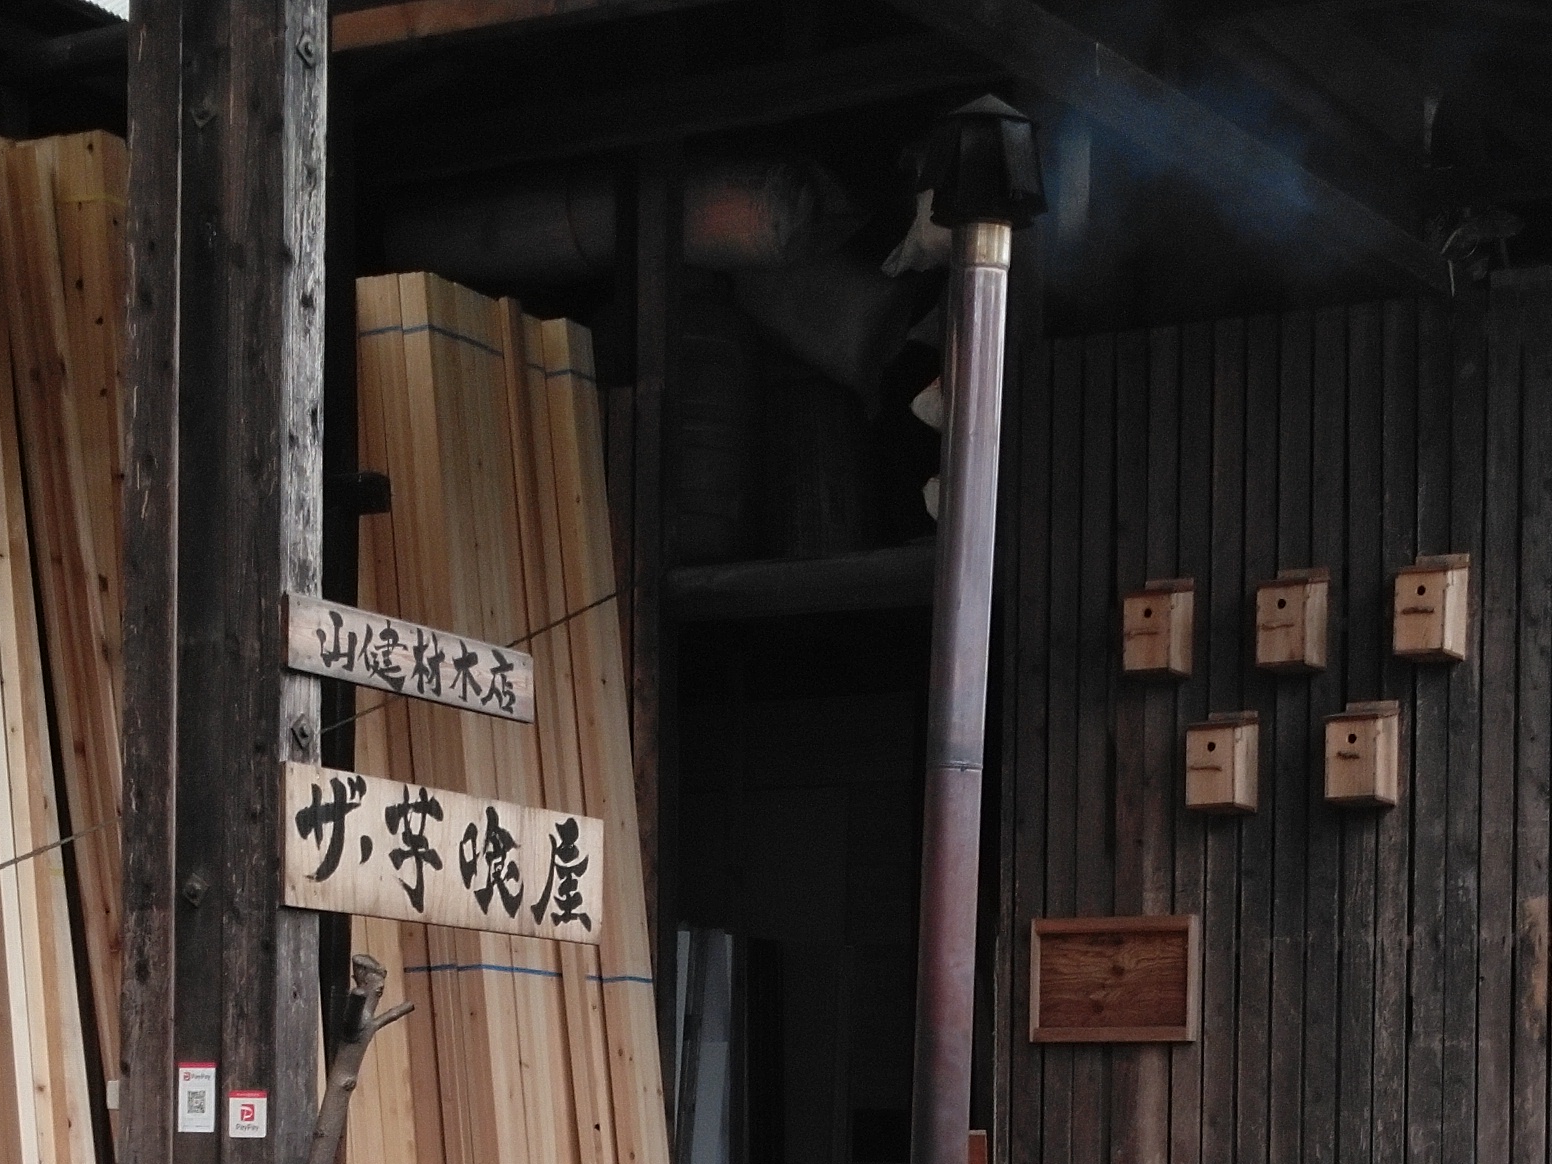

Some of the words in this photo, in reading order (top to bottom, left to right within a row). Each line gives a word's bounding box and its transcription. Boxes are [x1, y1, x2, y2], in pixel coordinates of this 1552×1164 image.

[316, 610, 517, 715] 山健材木店
